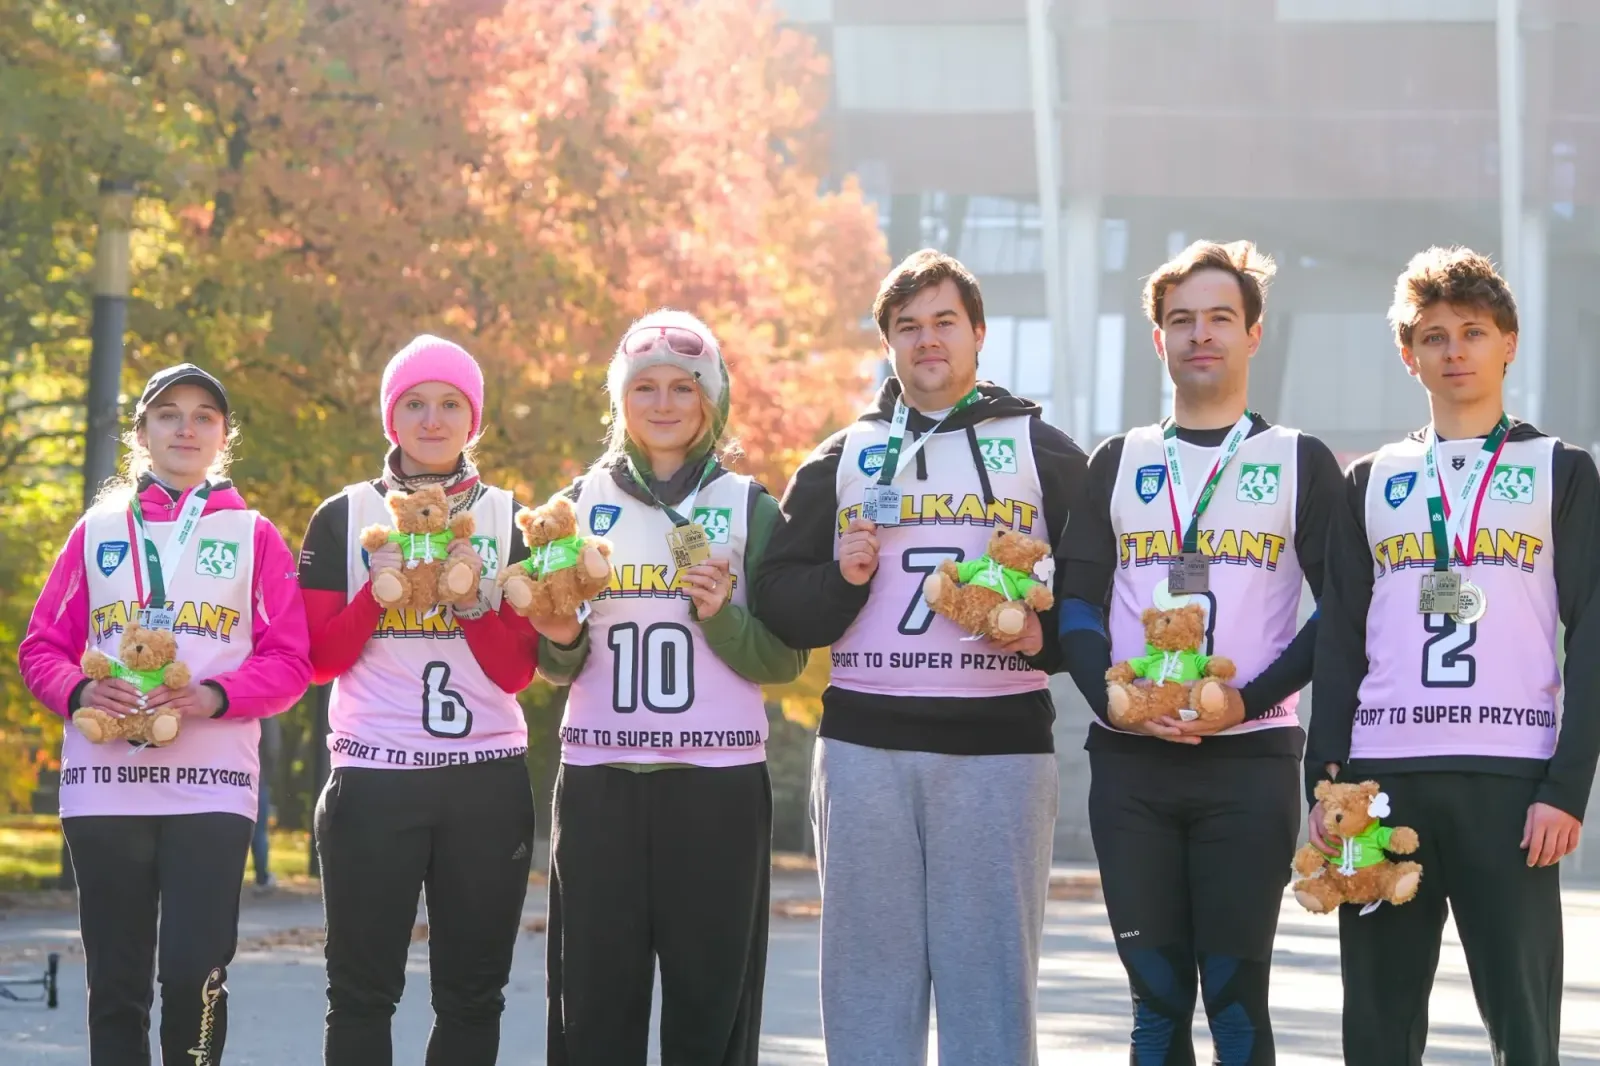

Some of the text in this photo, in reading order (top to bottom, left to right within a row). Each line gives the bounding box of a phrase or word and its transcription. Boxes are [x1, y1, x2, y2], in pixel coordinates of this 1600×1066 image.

[838, 494, 1039, 539] SLKANT
[1375, 528, 1543, 579] STALANT
[897, 546, 965, 636] 7
[91, 600, 240, 644] STAANT
[607, 621, 695, 714] 10
[831, 652, 1034, 672] SPORT TO SUPER PRZYGOD
[1421, 613, 1477, 689] 2
[422, 660, 473, 738] 6
[1353, 705, 1557, 728] PORT TO SUPER PRZYGODA
[333, 737, 381, 760] SPORT
[386, 748, 407, 765] TO
[413, 751, 469, 766] SUPER
[560, 726, 761, 748] PORT TO SUPER PRZYGODA
[60, 766, 88, 786] PORT
[92, 766, 111, 783] TO
[117, 766, 170, 784] SUPER
